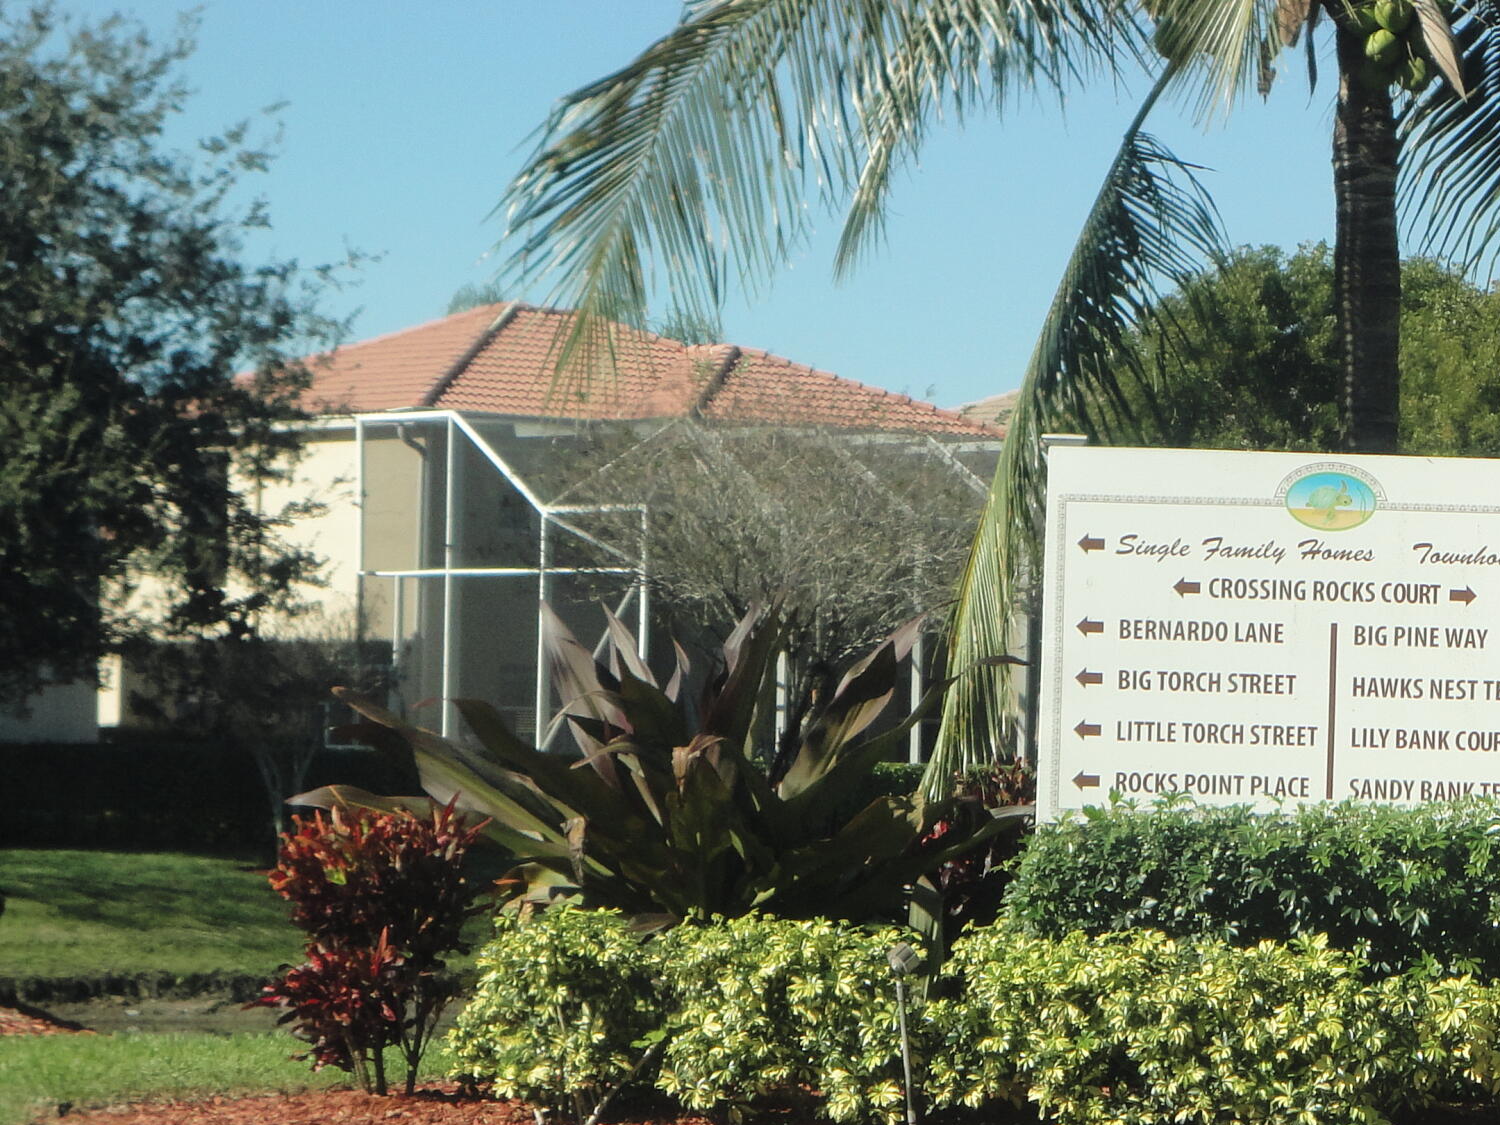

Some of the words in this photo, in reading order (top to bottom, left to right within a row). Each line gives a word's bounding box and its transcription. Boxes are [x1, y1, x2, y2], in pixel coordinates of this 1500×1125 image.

[1115, 534, 1190, 563] Single
[1201, 536, 1287, 566] Family
[1297, 539, 1375, 561] Homes
[1208, 578, 1306, 601] CROSSING
[1312, 580, 1376, 603] ROCKS
[1381, 582, 1441, 605] COURT
[1119, 619, 1228, 642] BERNARDO
[1234, 622, 1284, 644] LANE
[1354, 625, 1387, 647] BIG
[1394, 626, 1439, 648] PINE
[1445, 628, 1488, 649] WAY
[1118, 669, 1151, 691] BIG
[1156, 671, 1221, 693] TORCH
[1227, 673, 1297, 695] STREET
[1352, 676, 1424, 699] HAWKS
[1430, 679, 1479, 700] NEST
[1117, 721, 1177, 743] LITTLE
[1182, 722, 1244, 745] TORCH
[1250, 724, 1318, 746] STREET
[1351, 727, 1390, 748] LILY
[1395, 729, 1450, 750] BANK
[1115, 772, 1178, 793] ROCKS
[1184, 774, 1245, 795] POINT
[1250, 776, 1309, 798] PLACE
[1349, 778, 1415, 800] SANDY
[1421, 781, 1475, 802] BANK
